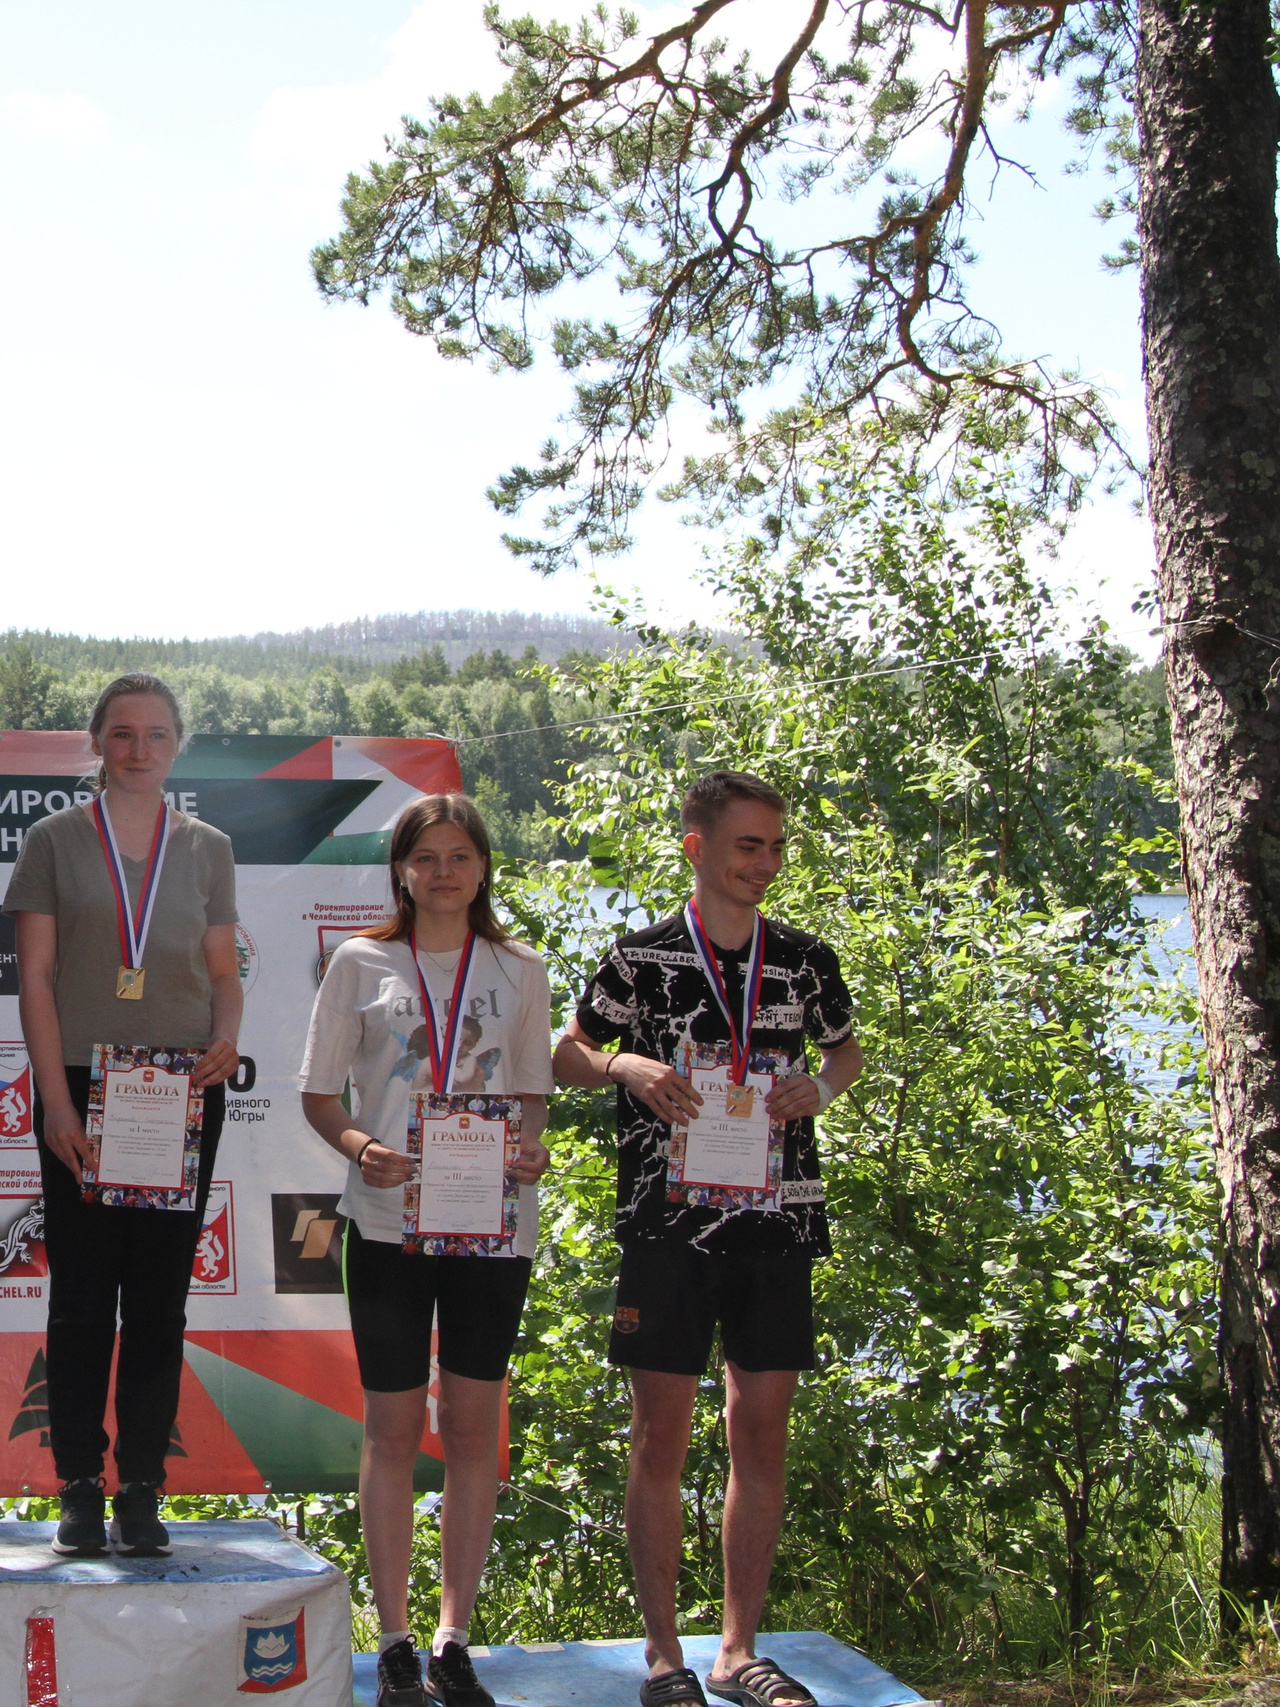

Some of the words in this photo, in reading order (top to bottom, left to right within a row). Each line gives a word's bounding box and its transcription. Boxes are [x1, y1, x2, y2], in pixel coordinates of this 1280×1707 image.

[314, 903, 384, 912] Ориентирование
[309, 913, 360, 921] Челябинской
[115, 1083, 179, 1097] ГРАМОТА
[700, 1081, 763, 1096] ГРАА
[229, 1109, 265, 1124] Югры
[431, 1131, 496, 1142] ГРАМОТА
